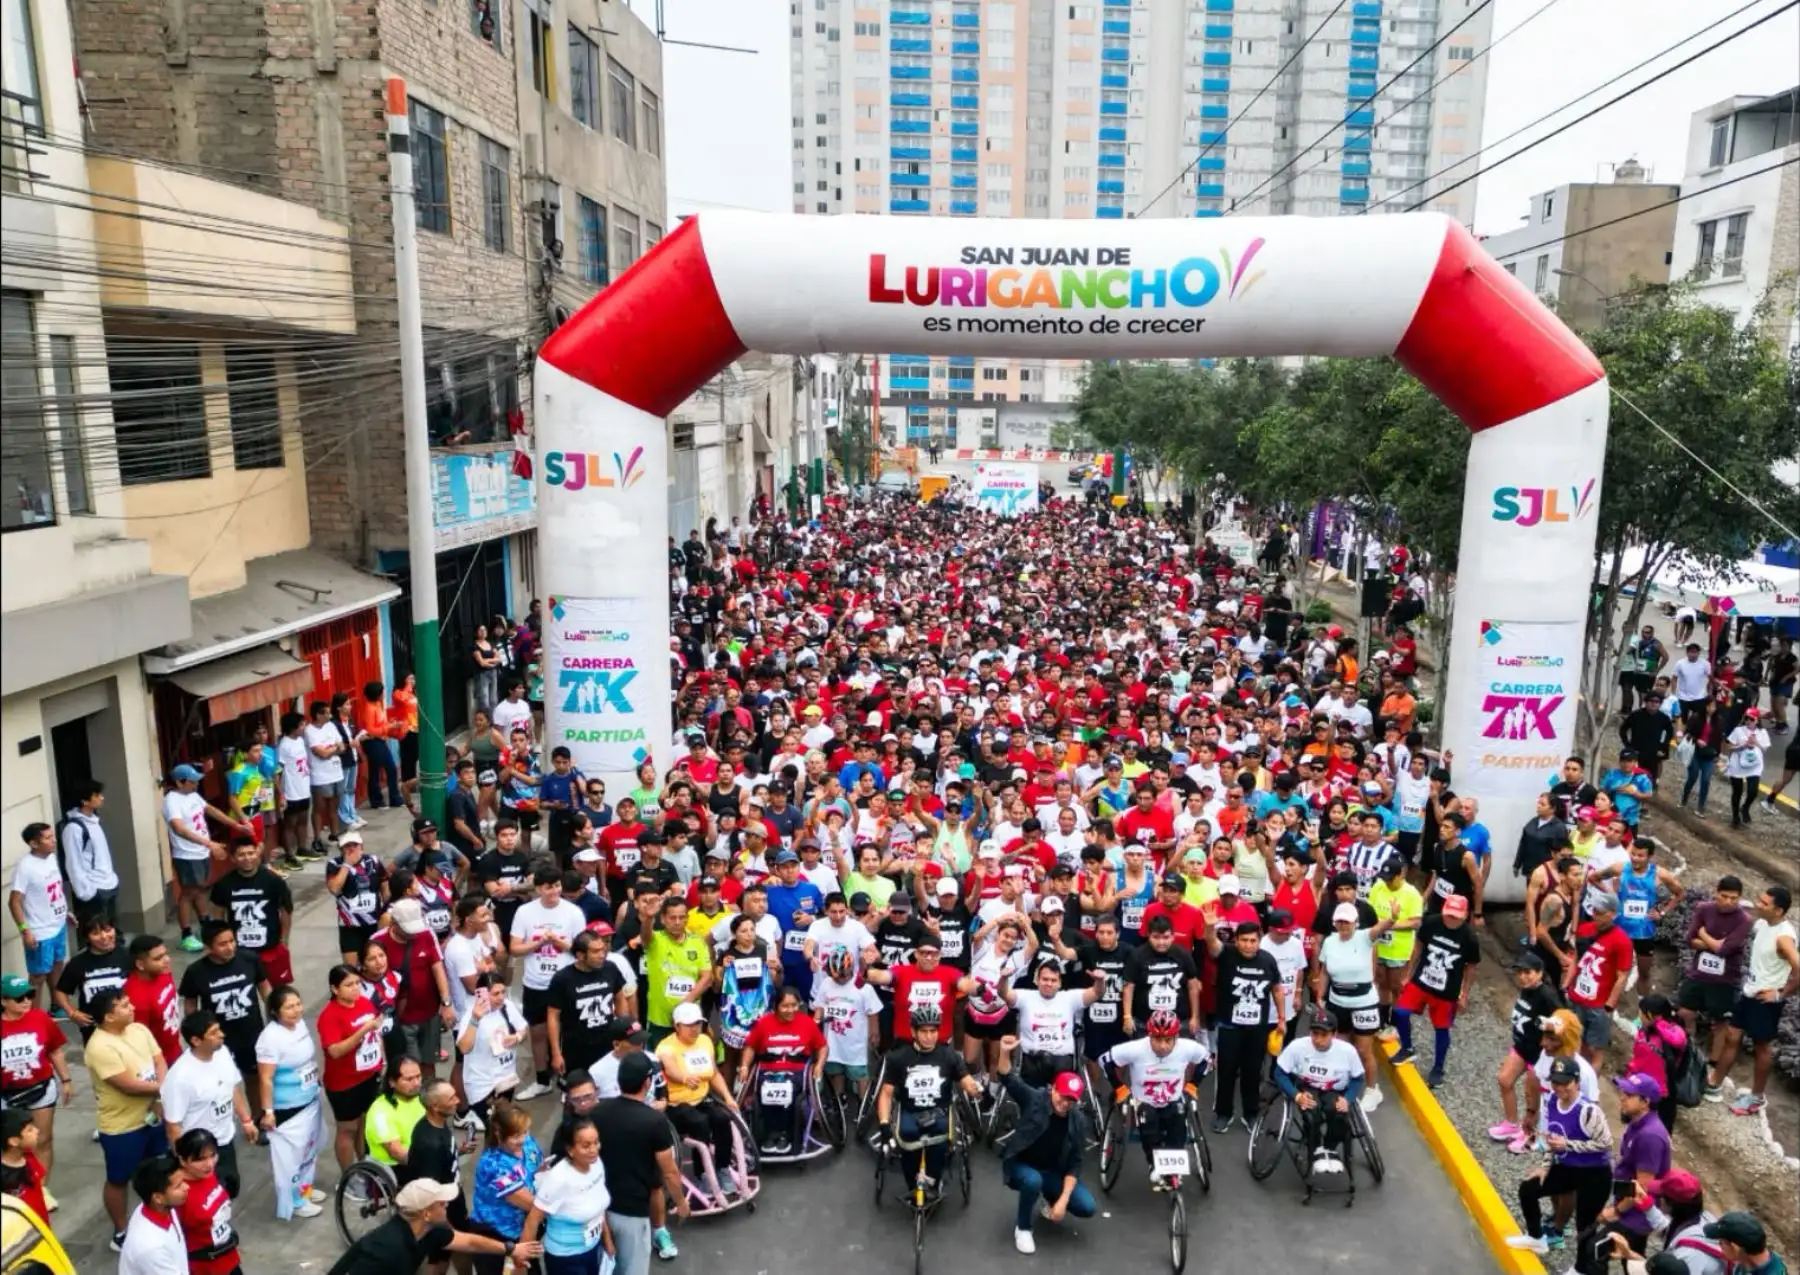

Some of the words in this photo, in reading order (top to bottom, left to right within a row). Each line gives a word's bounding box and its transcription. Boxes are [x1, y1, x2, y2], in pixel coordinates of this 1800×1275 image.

[960, 246, 1013, 265] SAN
[1021, 247, 1089, 266] JUAN
[1096, 247, 1130, 265] DE
[869, 254, 1220, 309] LURIGANCHO
[923, 316, 952, 333] es
[957, 315, 1083, 335] momento
[1089, 314, 1121, 335] de
[1126, 317, 1206, 334] crecer
[545, 451, 615, 491] SJL
[1492, 487, 1570, 527] SJL
[562, 657, 634, 669] CARRERA
[1490, 682, 1563, 695] CARRERA
[565, 728, 645, 743] PARTIDA
[1482, 754, 1562, 769] PARTIDA
[1309, 1065, 1328, 1076] 017
[914, 1077, 935, 1088] 567
